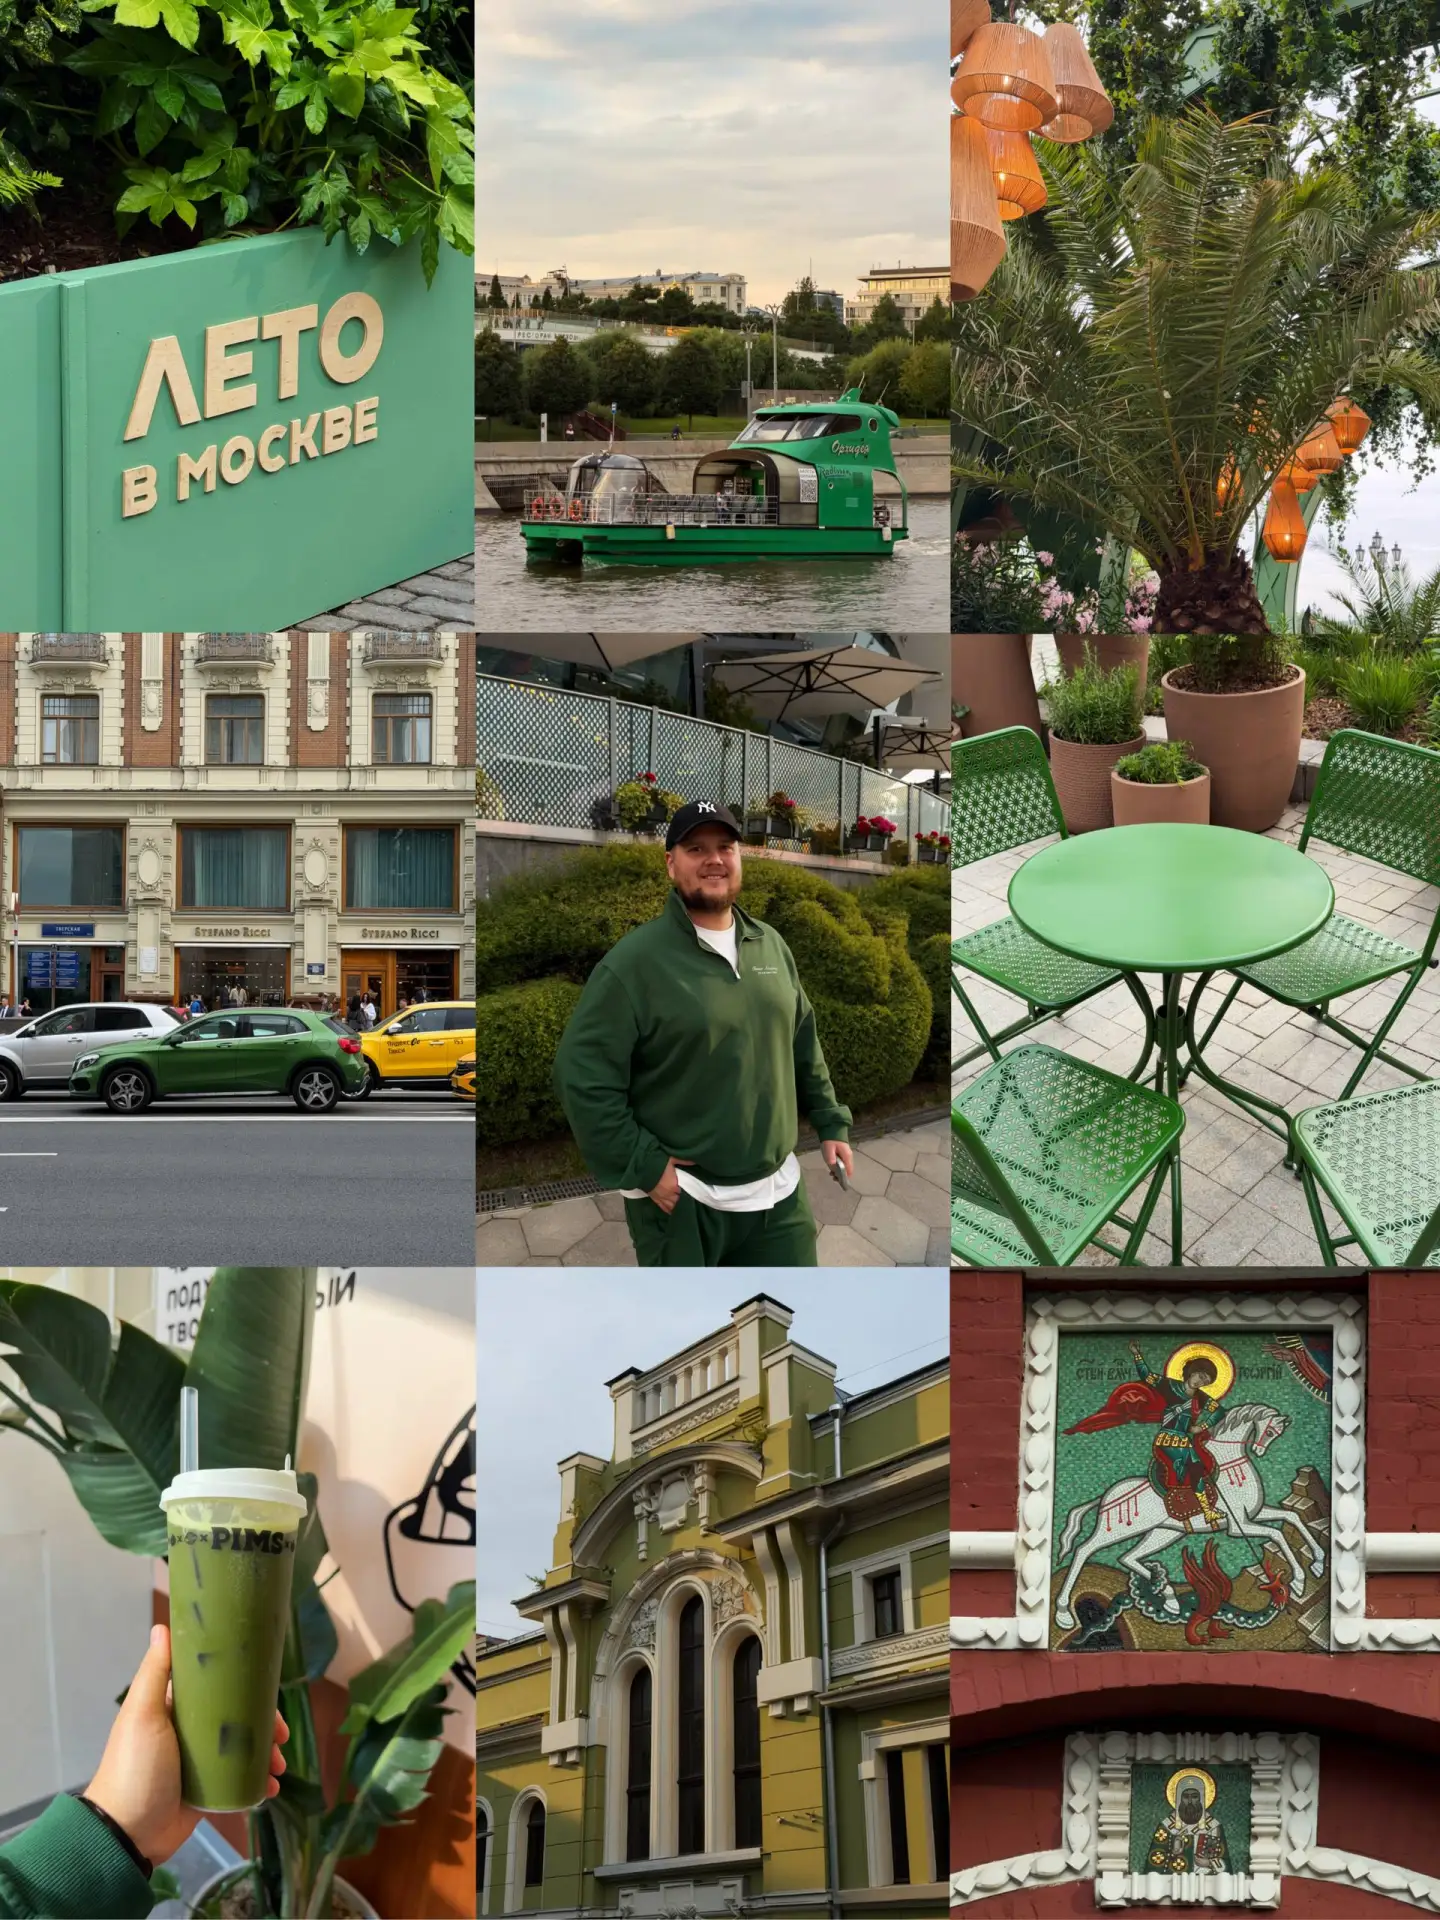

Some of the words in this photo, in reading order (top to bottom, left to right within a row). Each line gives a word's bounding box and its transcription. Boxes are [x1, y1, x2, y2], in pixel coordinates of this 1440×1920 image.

[123, 291, 384, 441] ЛЕТО
[122, 464, 158, 519] В
[176, 395, 380, 501] МОСКВЕ
[211, 1526, 284, 1555] PIMS
